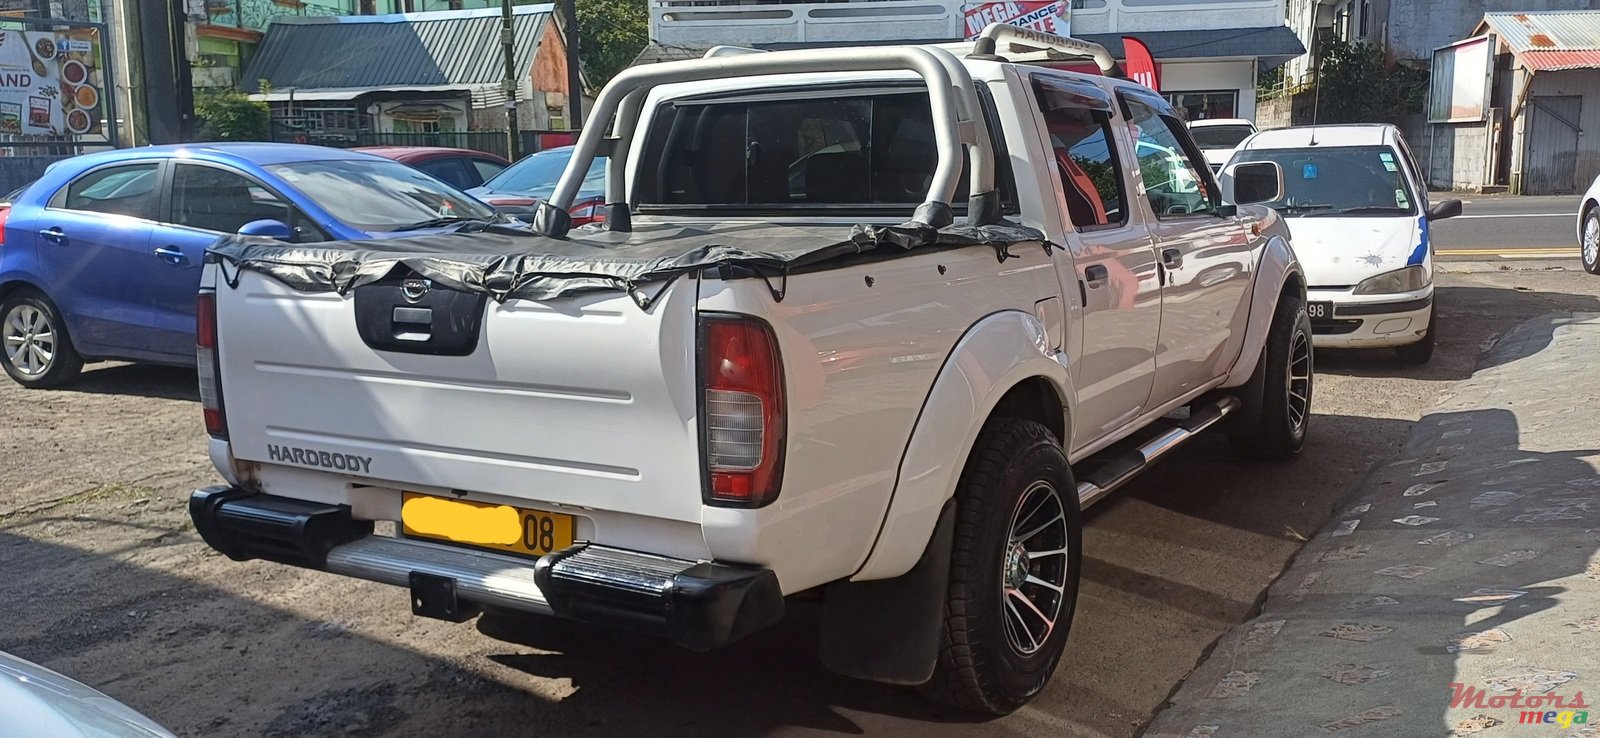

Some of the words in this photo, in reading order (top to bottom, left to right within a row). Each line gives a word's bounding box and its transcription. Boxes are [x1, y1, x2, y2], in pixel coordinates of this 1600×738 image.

[966, 1, 1021, 35] MEGA
[1014, 26, 1090, 52] HARDBODY
[1309, 304, 1324, 317] 98
[267, 444, 372, 473] HARDBODY
[523, 514, 554, 552] 08
